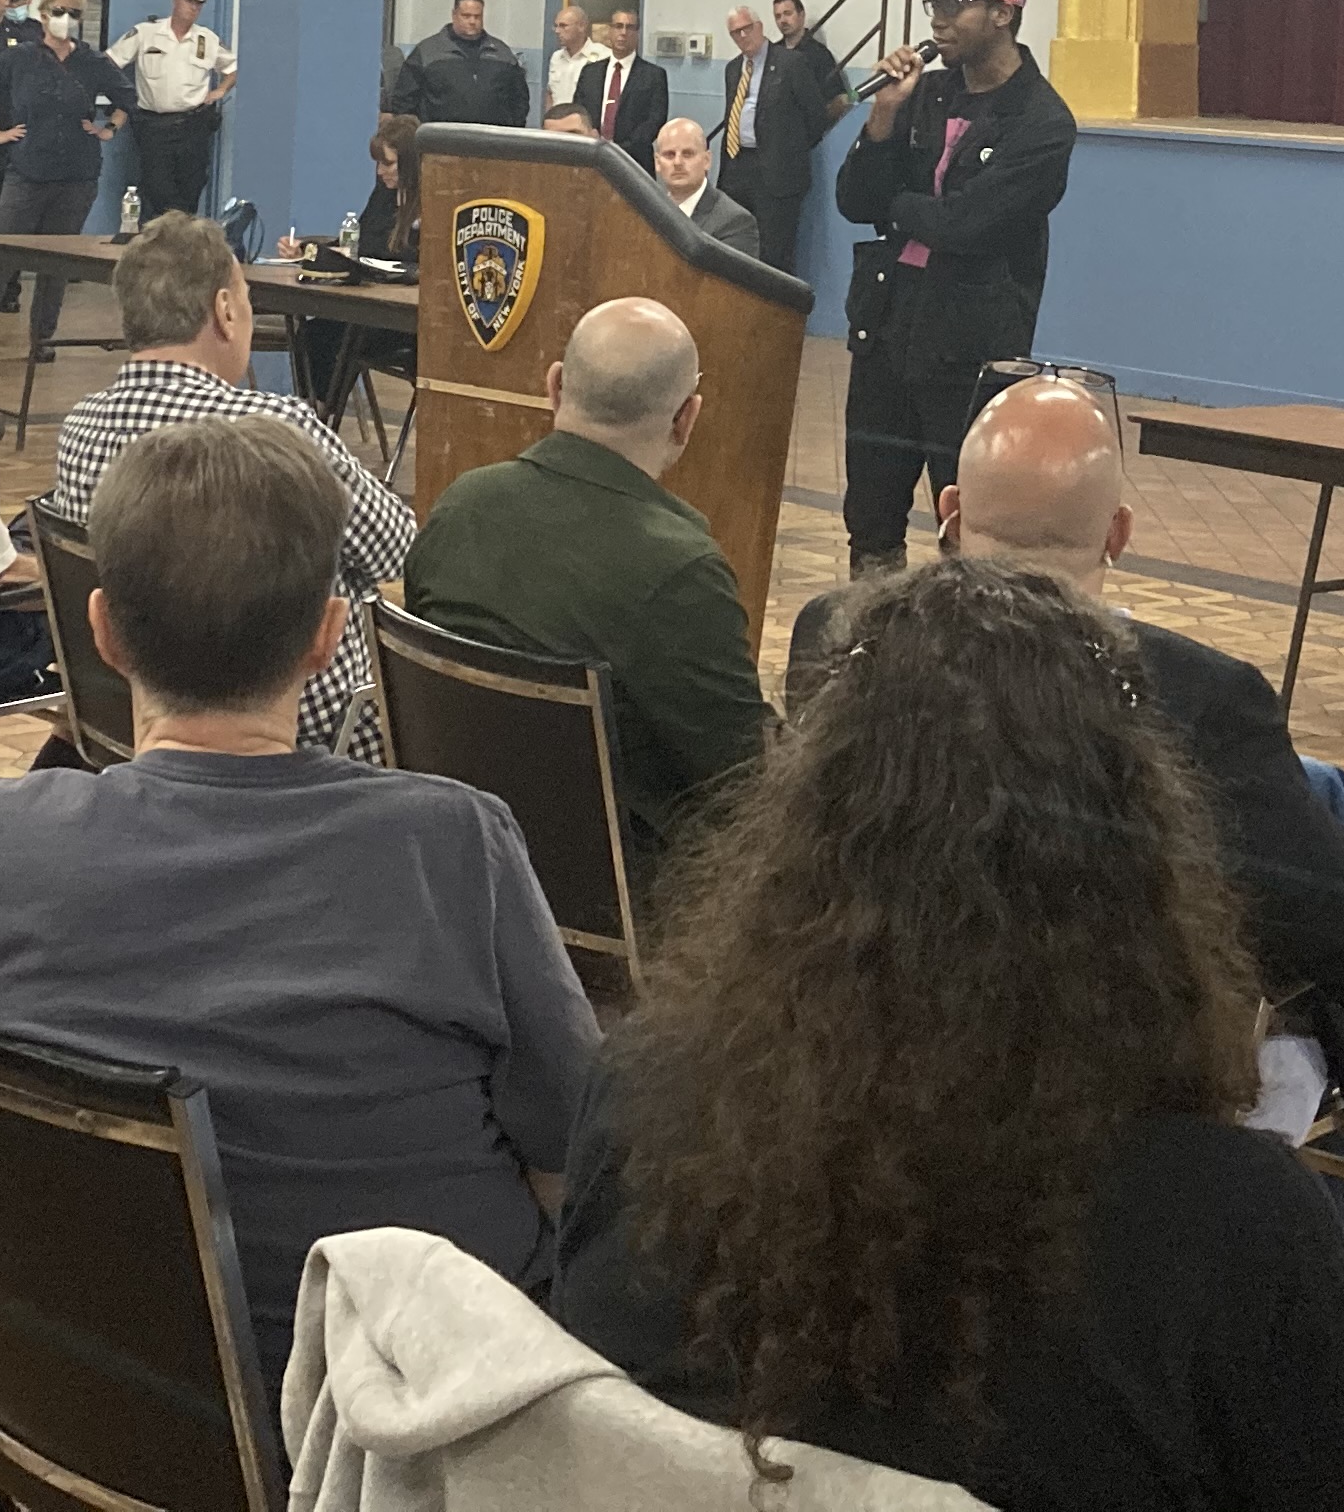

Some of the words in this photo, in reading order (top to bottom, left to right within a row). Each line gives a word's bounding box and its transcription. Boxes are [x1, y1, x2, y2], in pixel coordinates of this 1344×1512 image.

[457, 221, 526, 252] DEPARTMENT
[471, 207, 514, 228] POLICE
[457, 261, 470, 296] CITY
[467, 302, 480, 320] OF
[492, 305, 511, 332] NEW
[508, 260, 526, 298] YORK
